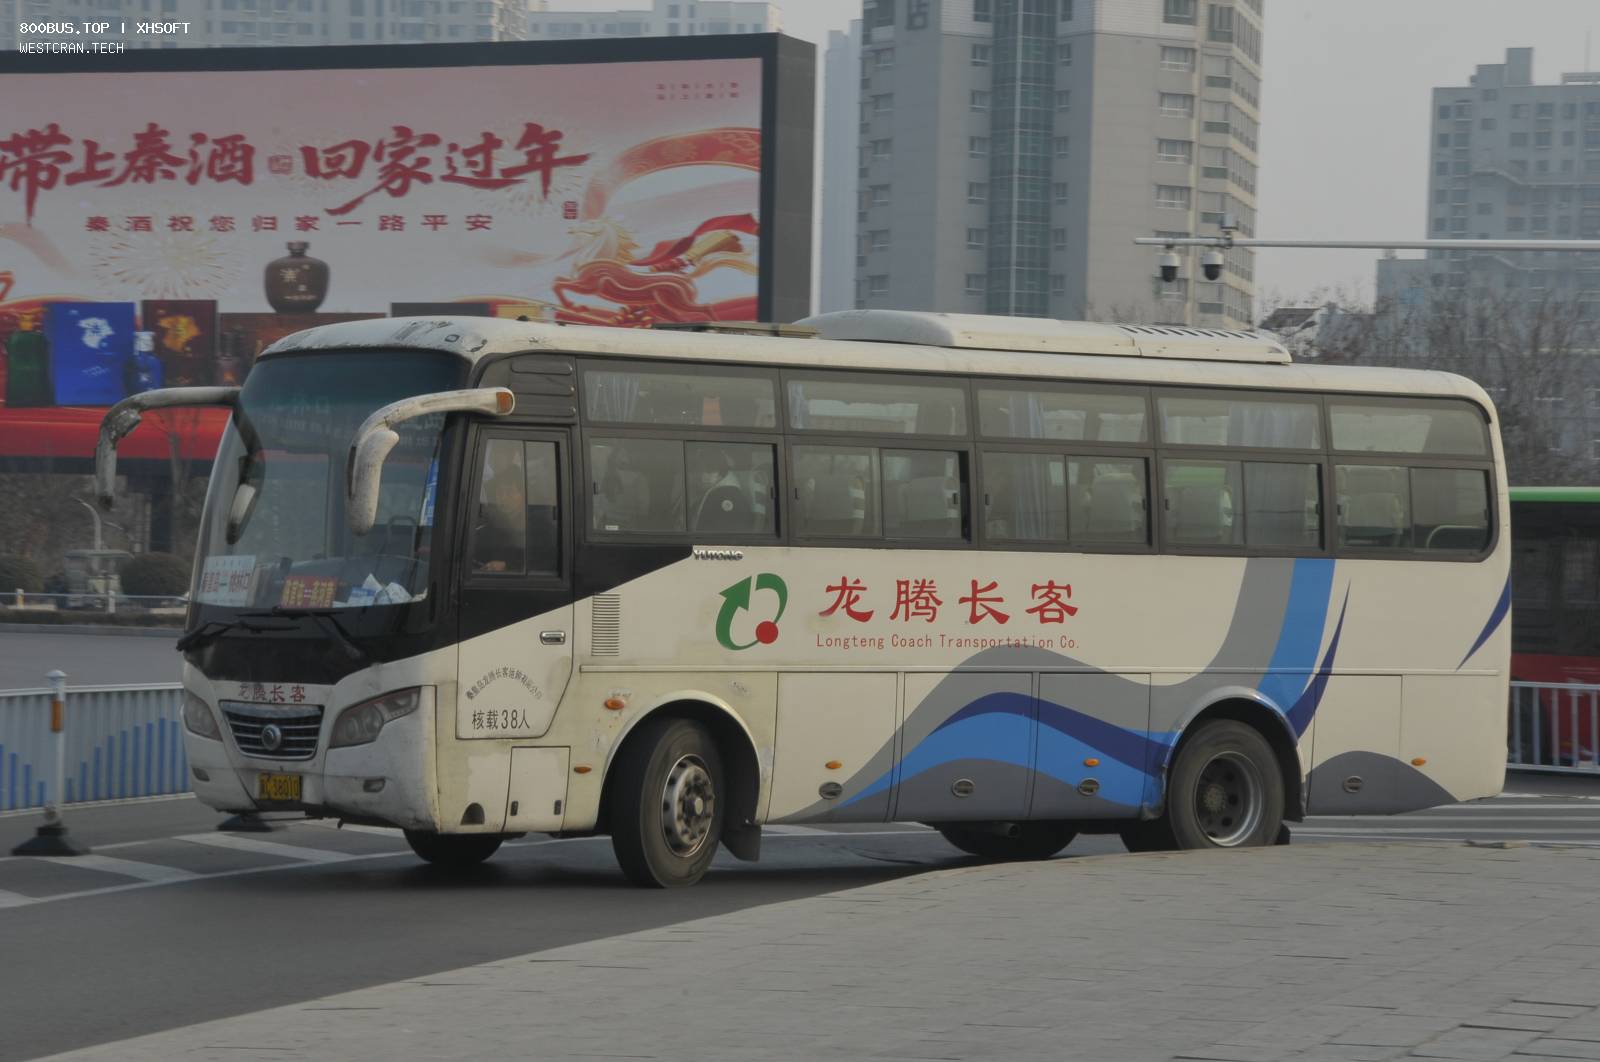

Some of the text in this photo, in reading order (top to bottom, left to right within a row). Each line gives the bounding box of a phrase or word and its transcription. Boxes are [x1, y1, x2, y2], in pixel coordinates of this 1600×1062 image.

[0, 122, 592, 229] 带上秦酒 回家过年
[85, 214, 493, 233] 秦酒祝您归家一路平安
[693, 549, 745, 561] YUTONG
[818, 576, 1079, 625] 龙腾长客
[816, 633, 1080, 650] Longteng Coach Transportation Co.
[471, 709, 530, 730] 核载38人
